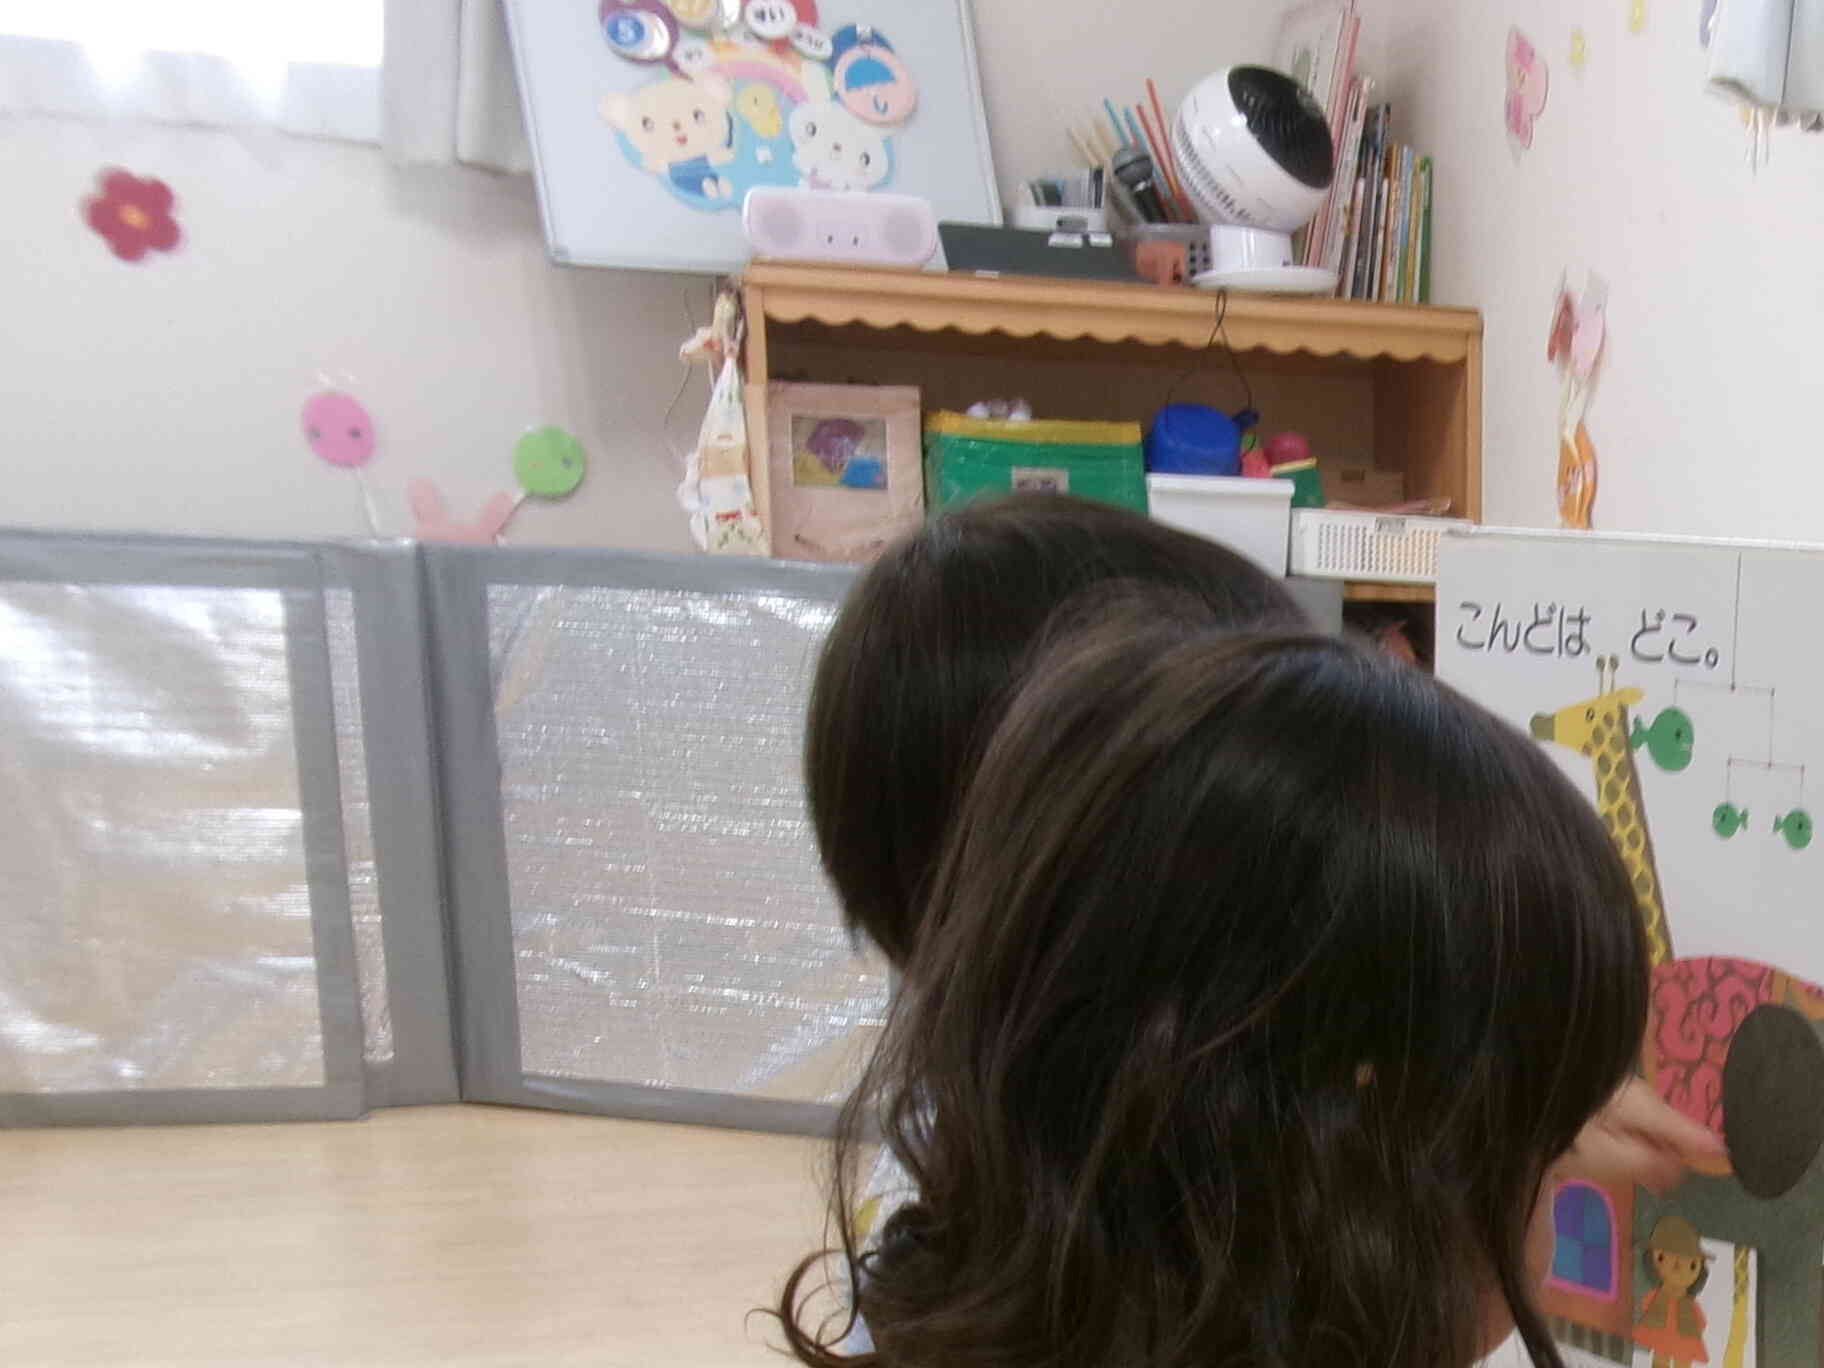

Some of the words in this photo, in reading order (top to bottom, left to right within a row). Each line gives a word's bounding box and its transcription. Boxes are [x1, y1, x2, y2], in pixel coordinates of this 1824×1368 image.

[1456, 601, 1592, 658] こんどは
[1631, 608, 1719, 669] どこ。
